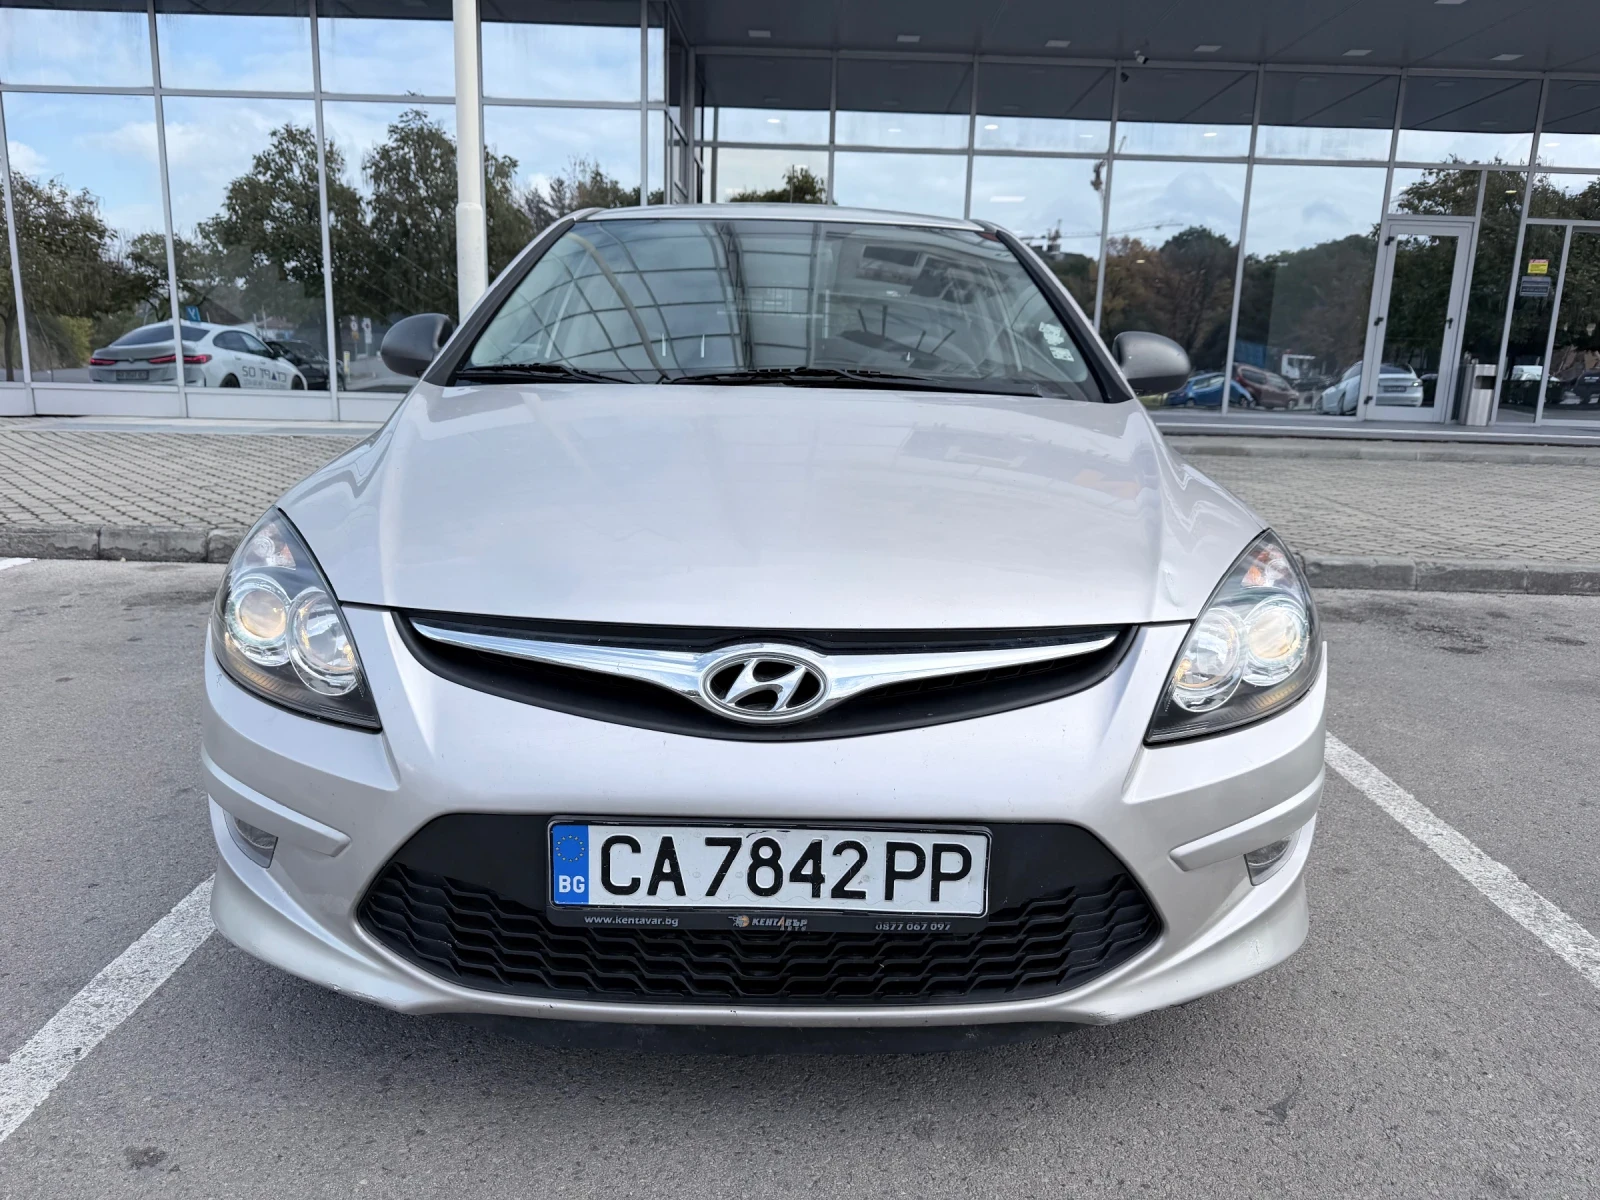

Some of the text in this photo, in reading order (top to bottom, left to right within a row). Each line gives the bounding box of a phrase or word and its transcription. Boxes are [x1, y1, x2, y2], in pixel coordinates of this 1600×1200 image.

[600, 834, 973, 902] CA 7842 PP
[558, 875, 586, 893] BG
[584, 915, 679, 927] www.kentavar.bg
[875, 921, 952, 931] 0877 067 097
